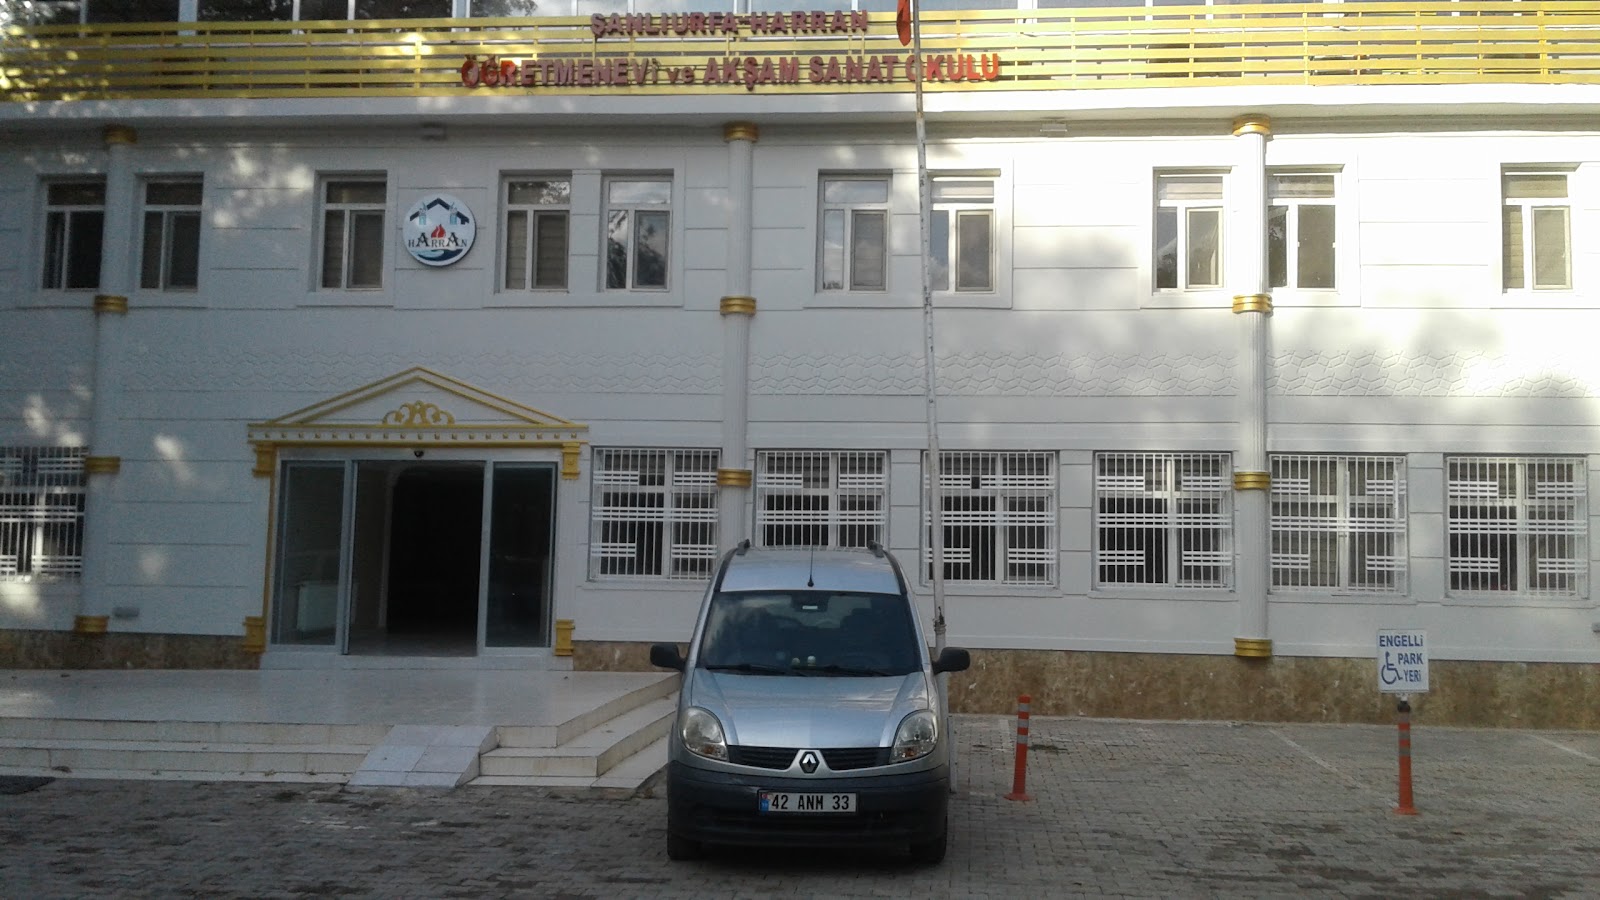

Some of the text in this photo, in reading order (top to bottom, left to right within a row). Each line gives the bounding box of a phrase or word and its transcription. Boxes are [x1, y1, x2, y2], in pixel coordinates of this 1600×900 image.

[666, 66, 695, 84] ve
[703, 57, 799, 91] AKŞAM
[809, 55, 899, 83] SANAT
[905, 53, 999, 82] OKULU
[408, 232, 468, 248] HARRAN
[1397, 652, 1424, 665] PARK
[771, 794, 789, 810] 42
[797, 795, 824, 810] ANM
[832, 795, 850, 810] 33
